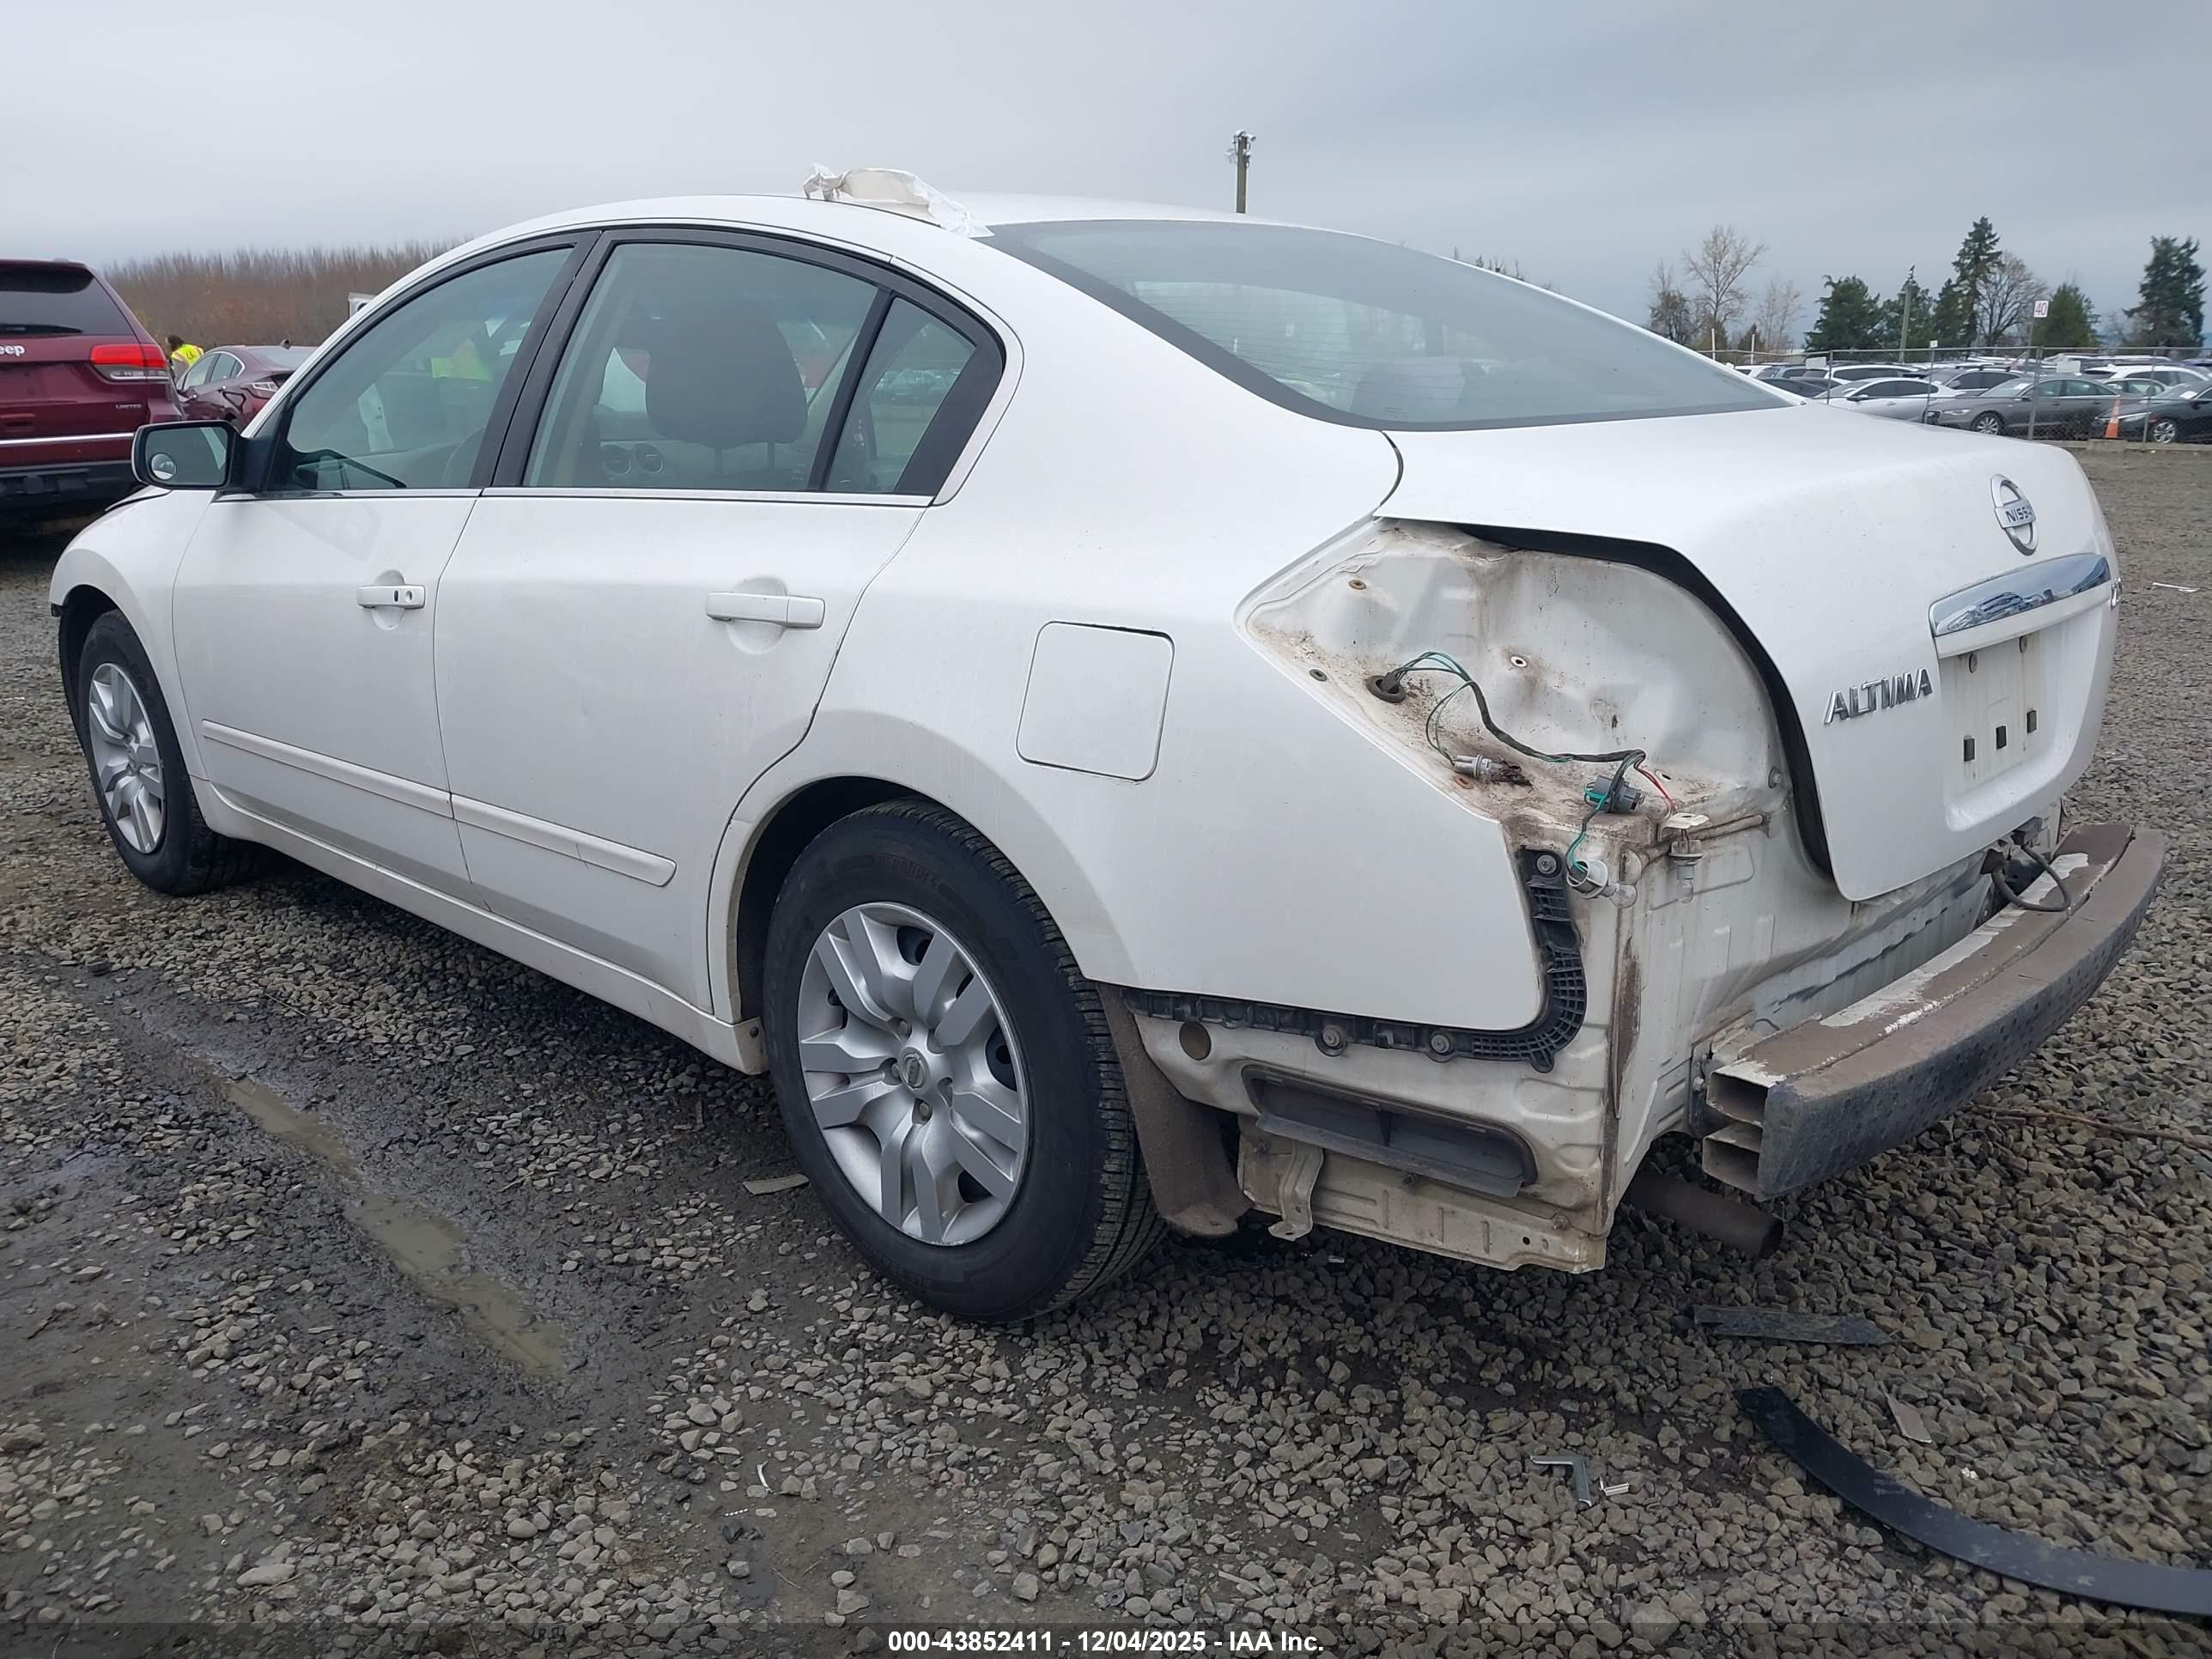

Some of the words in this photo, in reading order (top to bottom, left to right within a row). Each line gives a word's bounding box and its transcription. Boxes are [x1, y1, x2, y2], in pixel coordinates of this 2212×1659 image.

[2035, 301, 2047, 316] 40
[0, 344, 26, 357] eep
[2005, 504, 2034, 523] NISSA
[1824, 667, 1933, 725] ALTIMA
